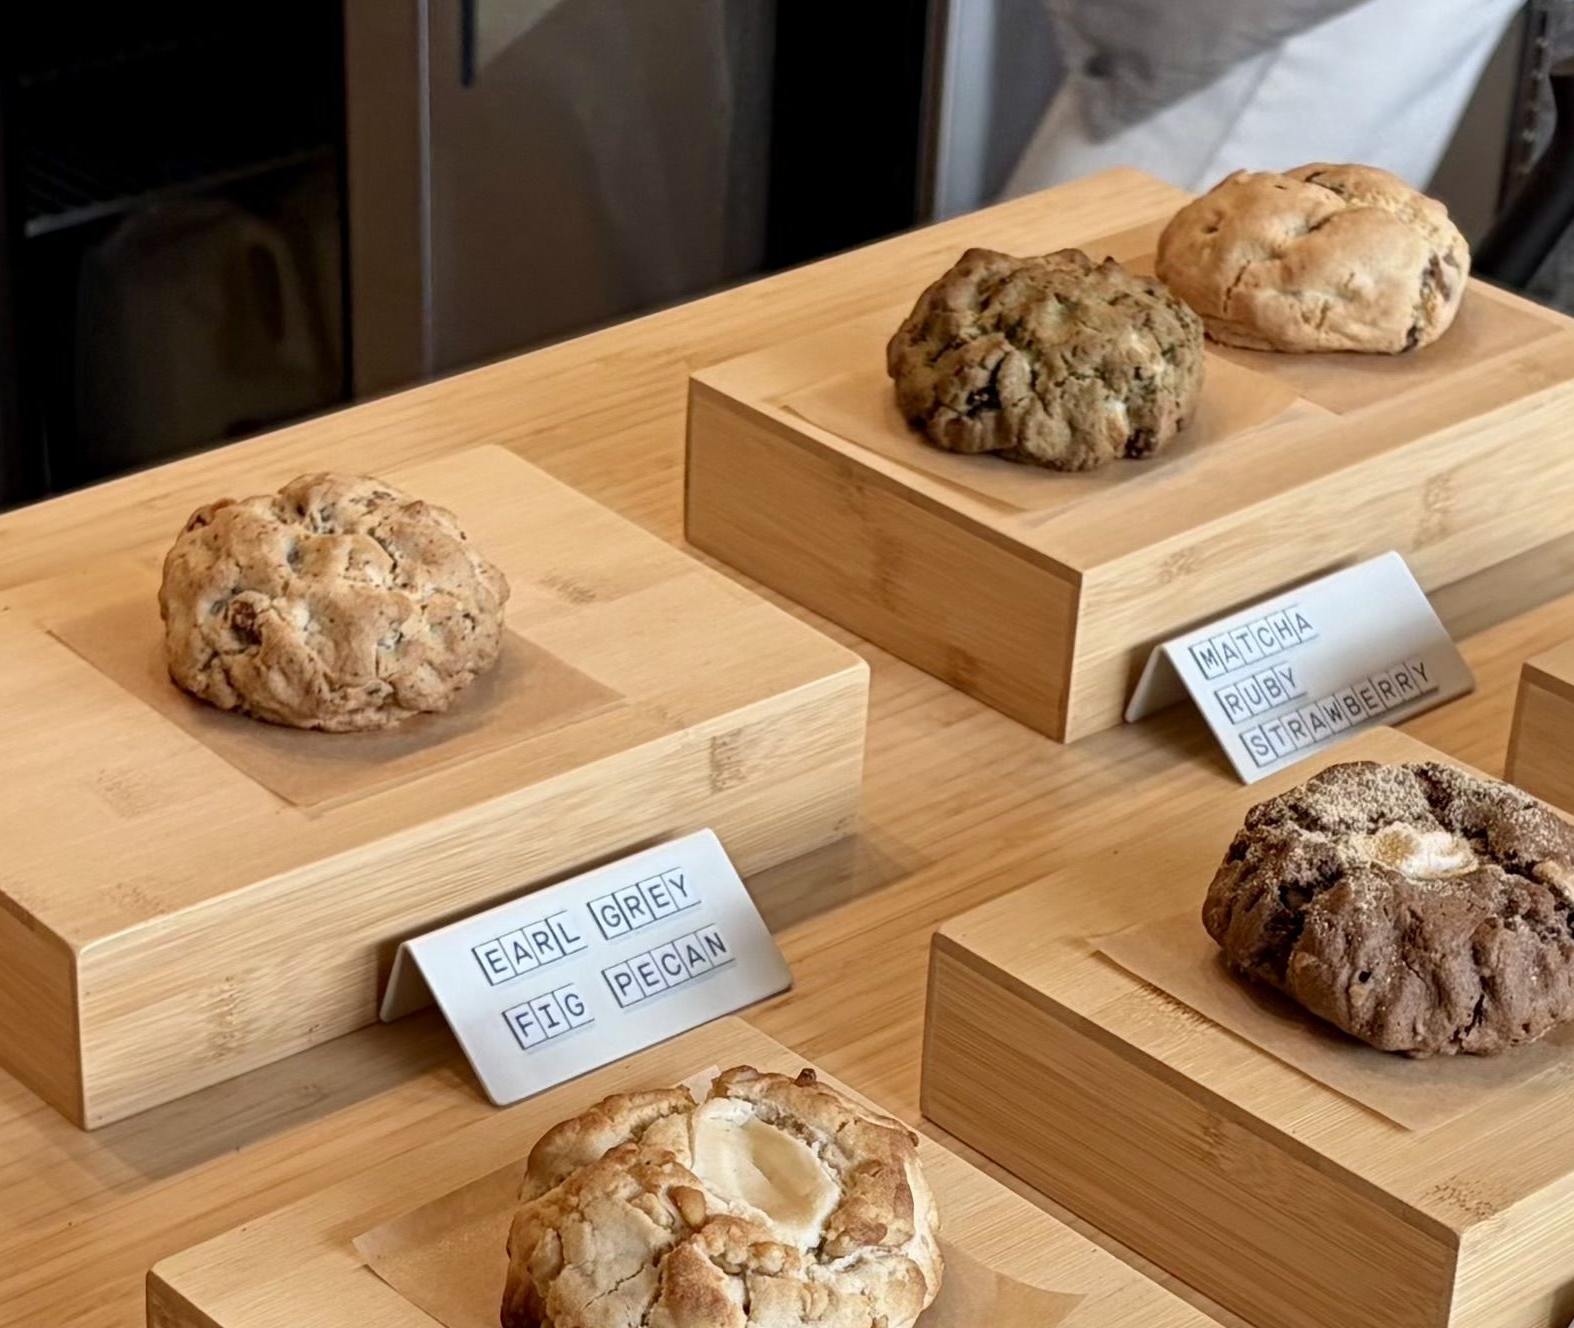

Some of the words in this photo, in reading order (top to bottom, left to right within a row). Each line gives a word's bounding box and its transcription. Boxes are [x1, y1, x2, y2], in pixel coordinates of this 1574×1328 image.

[1199, 611, 1314, 672] MATCHA
[1222, 669, 1299, 716] RUBY
[1249, 661, 1430, 759] STRAWBERRY
[484, 921, 581, 975] EARL
[599, 873, 688, 929] GREY
[514, 991, 586, 1038] FIG
[614, 931, 728, 997] PECAN
